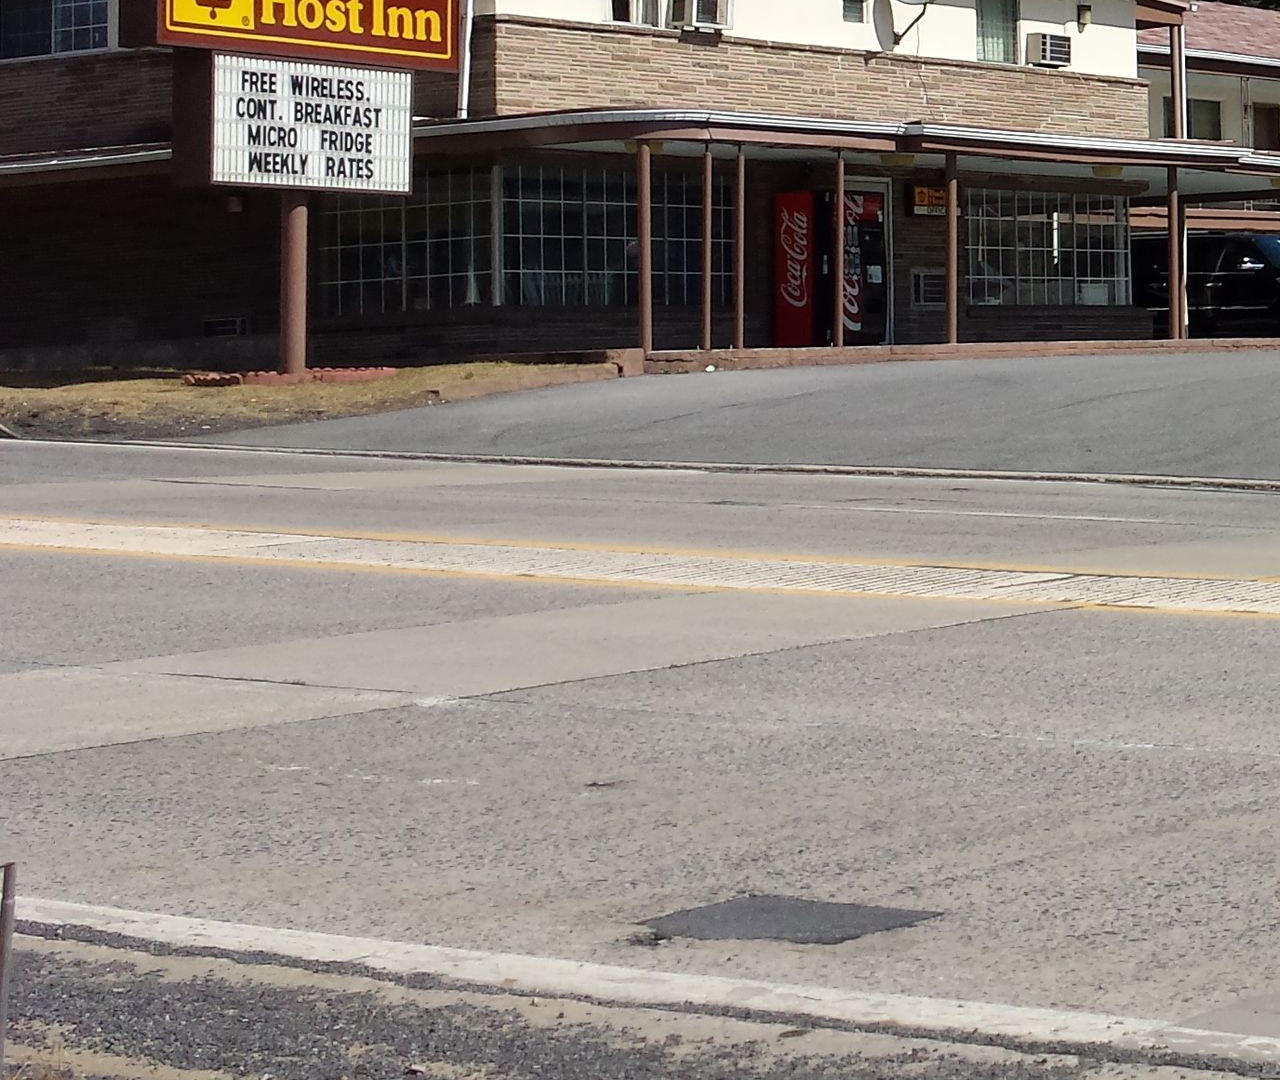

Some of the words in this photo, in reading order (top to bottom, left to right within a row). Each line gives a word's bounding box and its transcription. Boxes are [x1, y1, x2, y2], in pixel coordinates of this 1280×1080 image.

[241, 71, 277, 94] FREE
[236, 97, 283, 121] CONT.
[294, 102, 382, 128] BREAKFAST
[247, 125, 298, 148] MICRO
[320, 130, 373, 154] FRIDGE
[250, 152, 308, 175] WEEKLY
[326, 158, 374, 180] RATES
